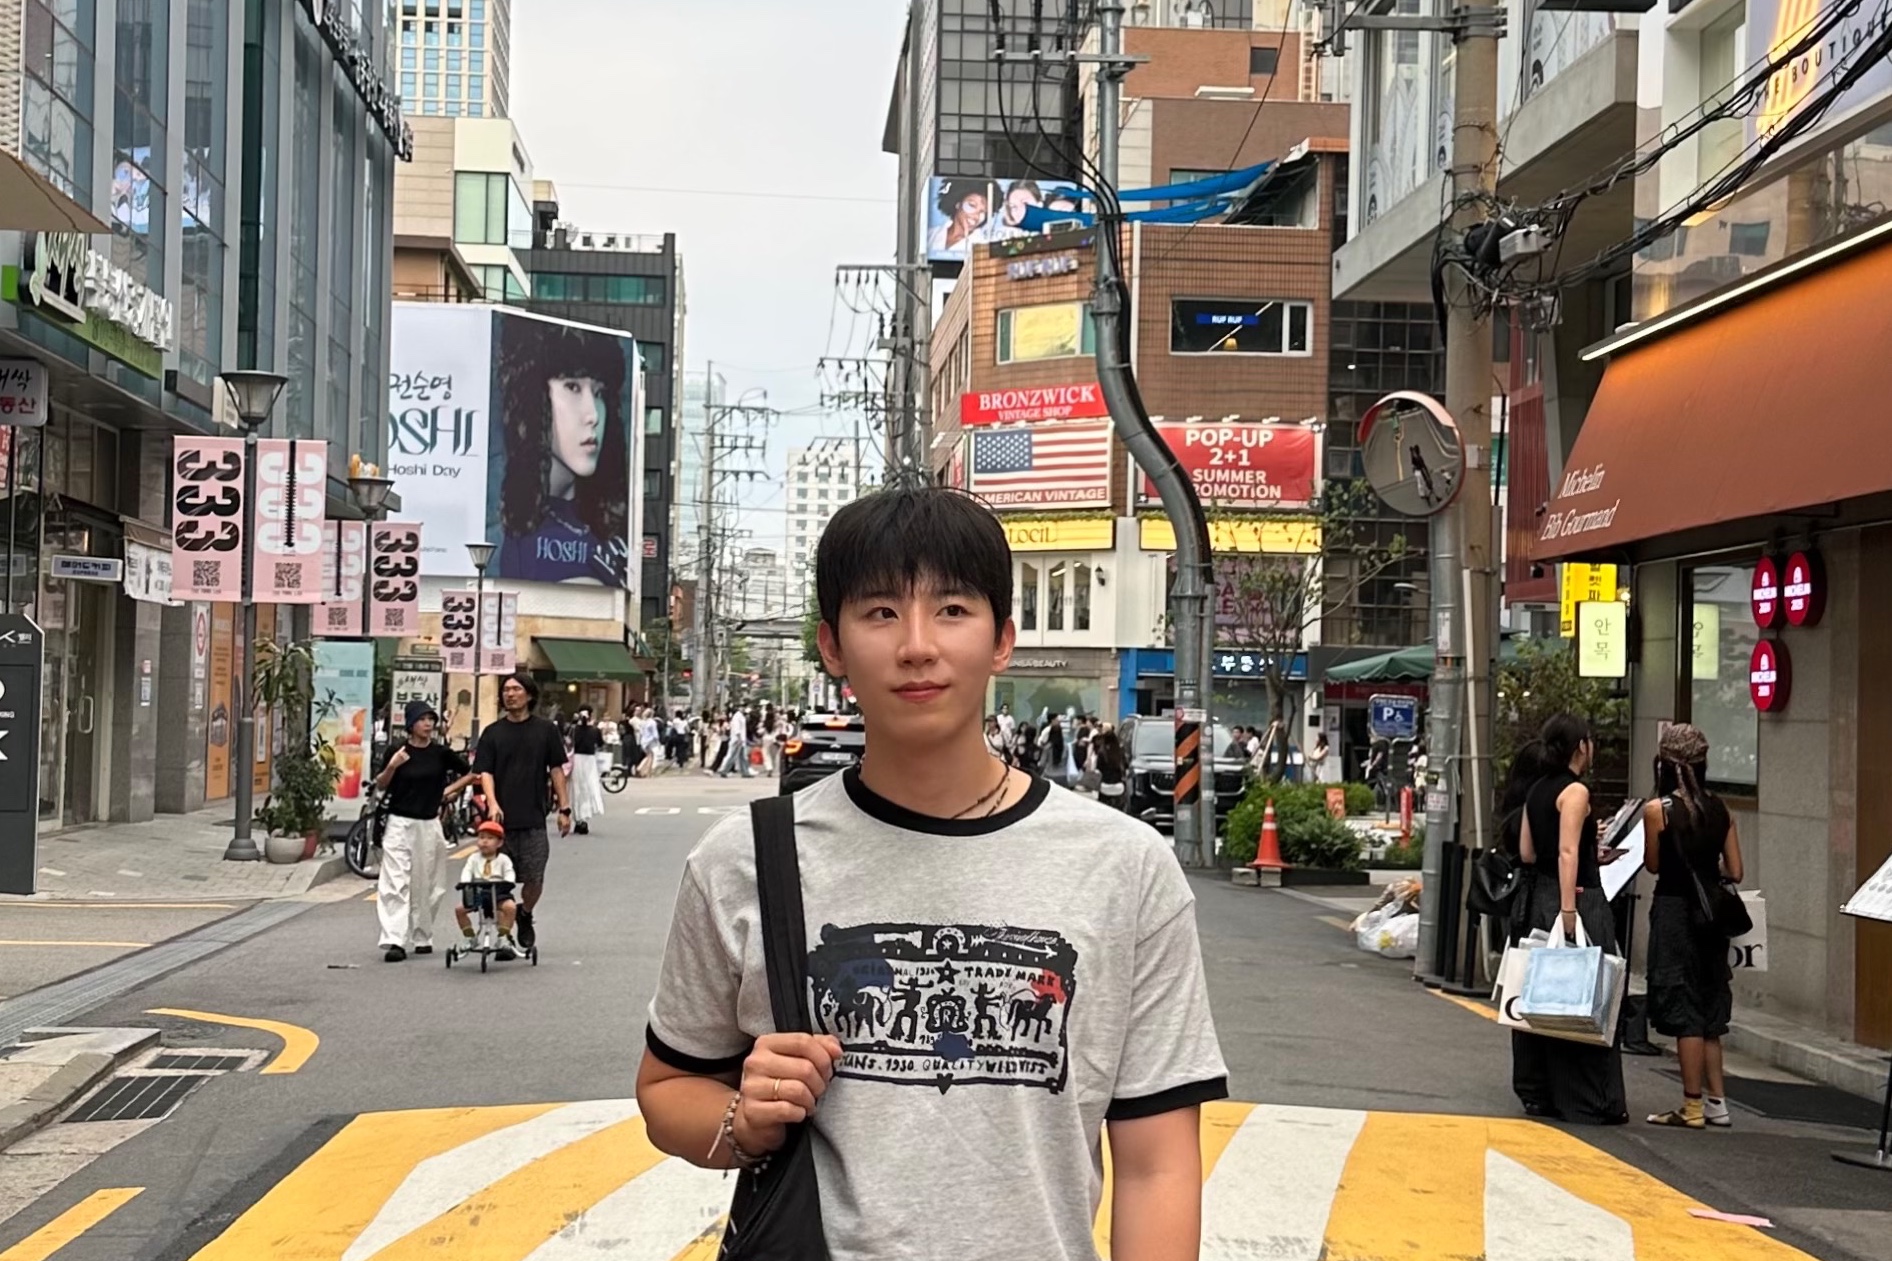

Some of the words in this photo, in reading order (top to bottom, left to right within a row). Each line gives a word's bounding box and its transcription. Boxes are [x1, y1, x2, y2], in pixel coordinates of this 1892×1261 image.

[979, 385, 1096, 411] BRONZWICK
[998, 408, 1041, 421] VINTAGE
[1043, 406, 1073, 418] SHOP
[1185, 429, 1274, 448] POP-UP
[1209, 447, 1251, 466] 2+1
[433, 464, 461, 479] Day
[1193, 469, 1267, 484] SUMMER
[1557, 463, 1606, 500] Michelin
[975, 491, 1042, 504] AMERICAN
[1045, 488, 1106, 501] VINTAGE
[1540, 511, 1562, 542] Bib
[1560, 498, 1621, 538] Gourmand
[536, 537, 587, 564] HOSHI
[1594, 617, 1612, 661] 안목
[1382, 707, 1394, 721] P
